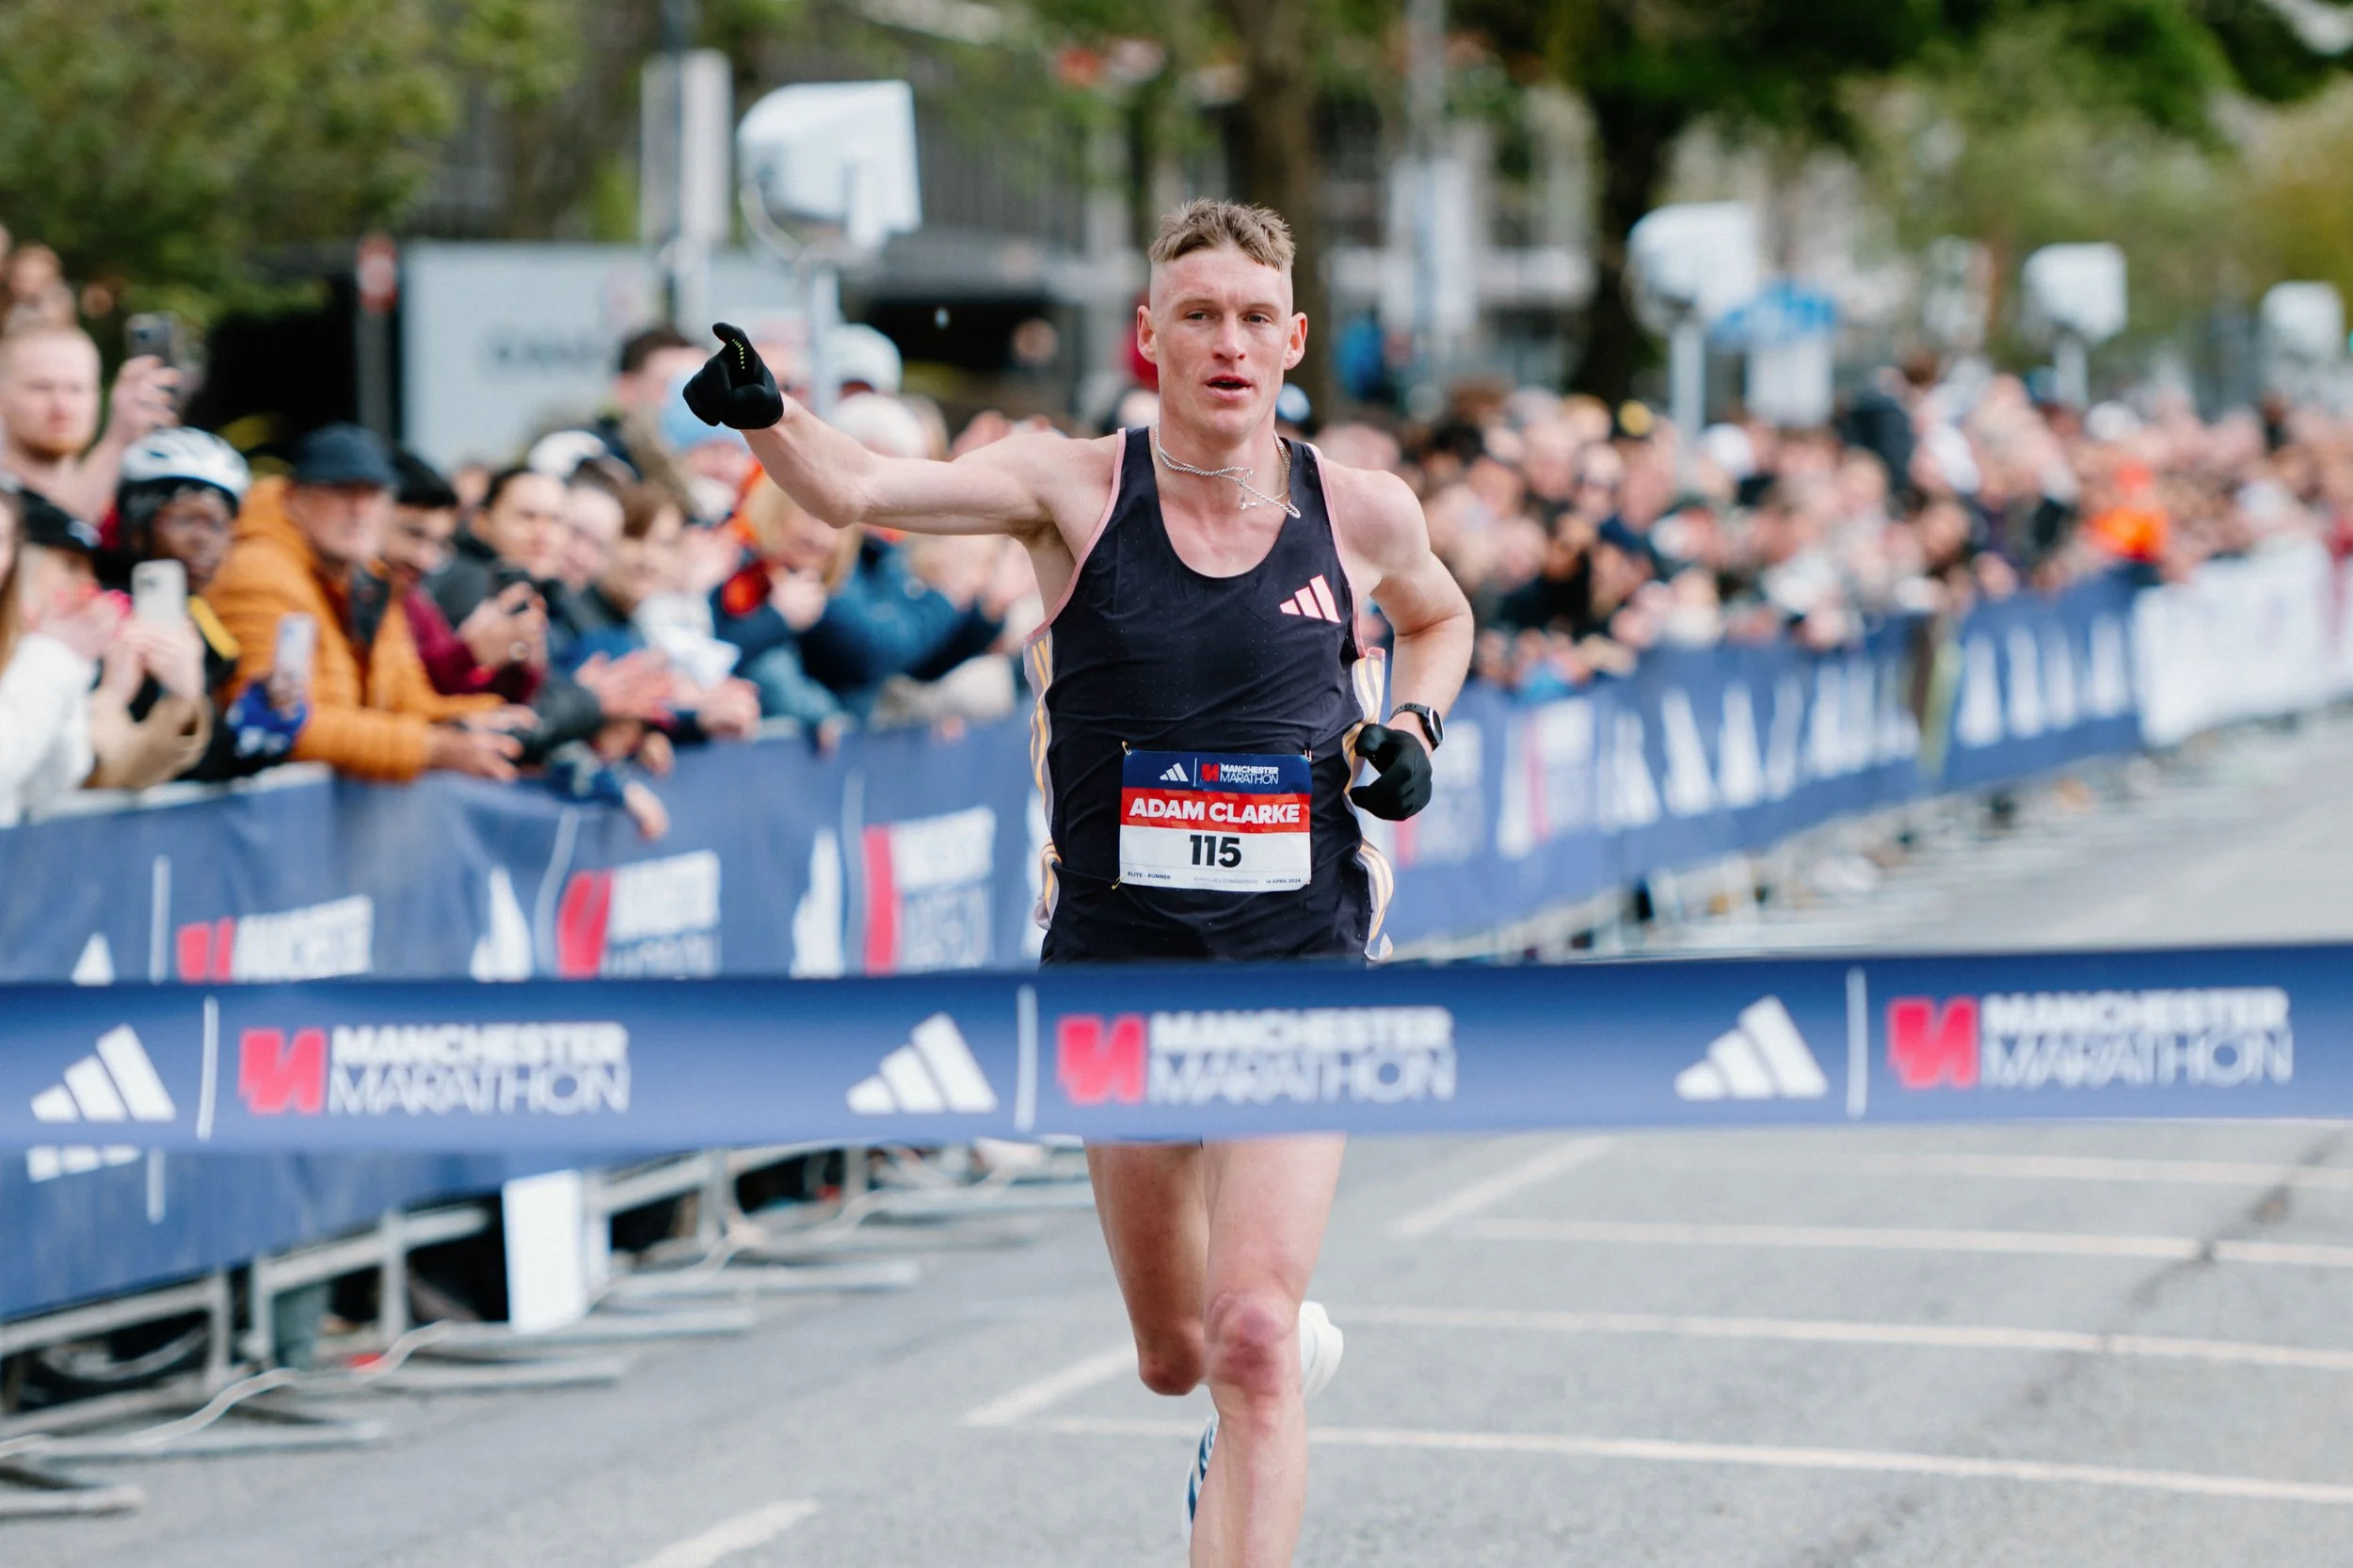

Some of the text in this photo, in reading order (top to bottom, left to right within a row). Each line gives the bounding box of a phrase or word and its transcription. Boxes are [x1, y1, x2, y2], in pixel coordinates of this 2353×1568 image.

[1219, 772, 1279, 785] MARATHON
[1220, 763, 1279, 775] MANCHESTER
[1128, 797, 1301, 824] ADAM CLARKE
[1189, 834, 1241, 868] 115
[1150, 1006, 1454, 1055] MANCHESTER
[1981, 987, 2289, 1036] MANCHESTER
[331, 1022, 629, 1065] MANCHESTER
[1981, 1032, 2294, 1089] MARATHON
[329, 1063, 631, 1116] MARATHON
[1149, 1049, 1456, 1105] MARATHON
